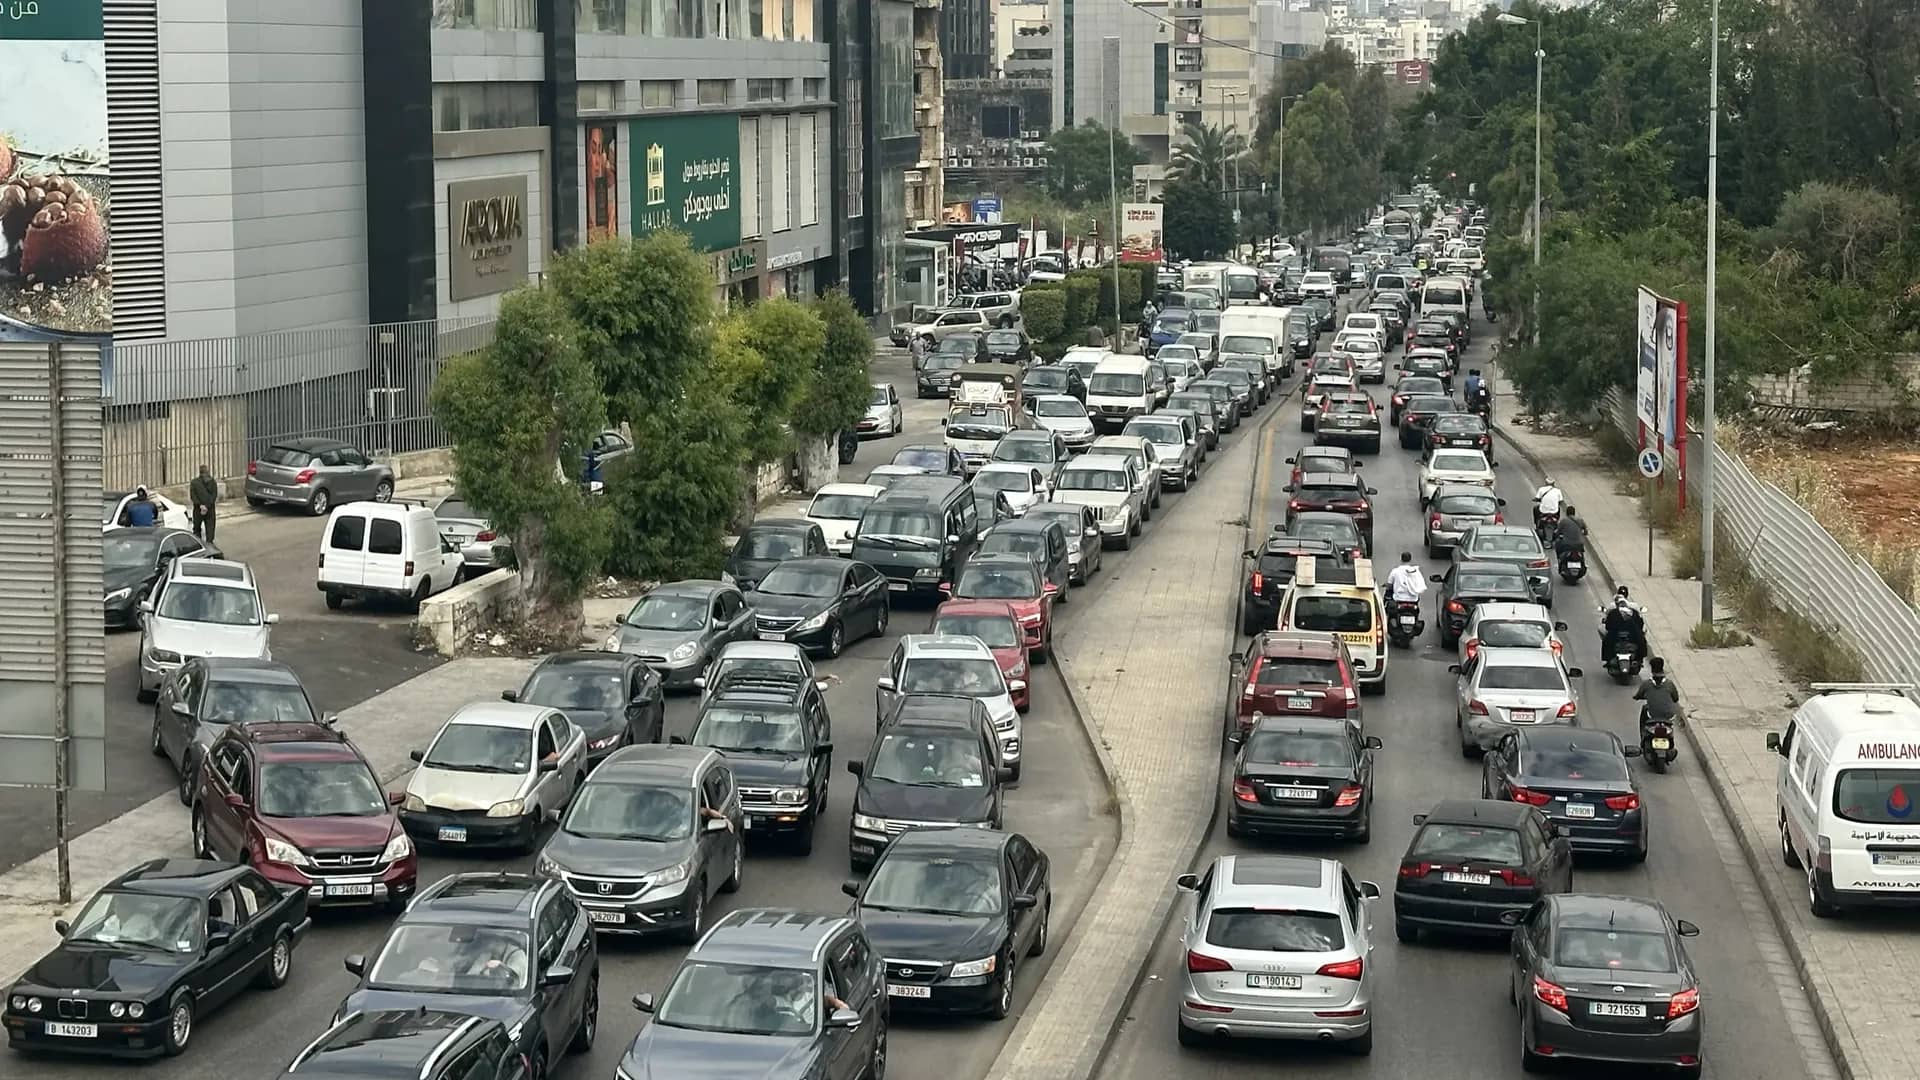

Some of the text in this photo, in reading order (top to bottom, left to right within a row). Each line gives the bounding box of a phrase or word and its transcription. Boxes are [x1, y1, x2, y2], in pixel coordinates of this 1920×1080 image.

[641, 208, 672, 232] HALLAB
[1858, 743, 1920, 759] AMBULAN
[1265, 975, 1296, 987] 190143
[1596, 1003, 1641, 1016] B 321555
